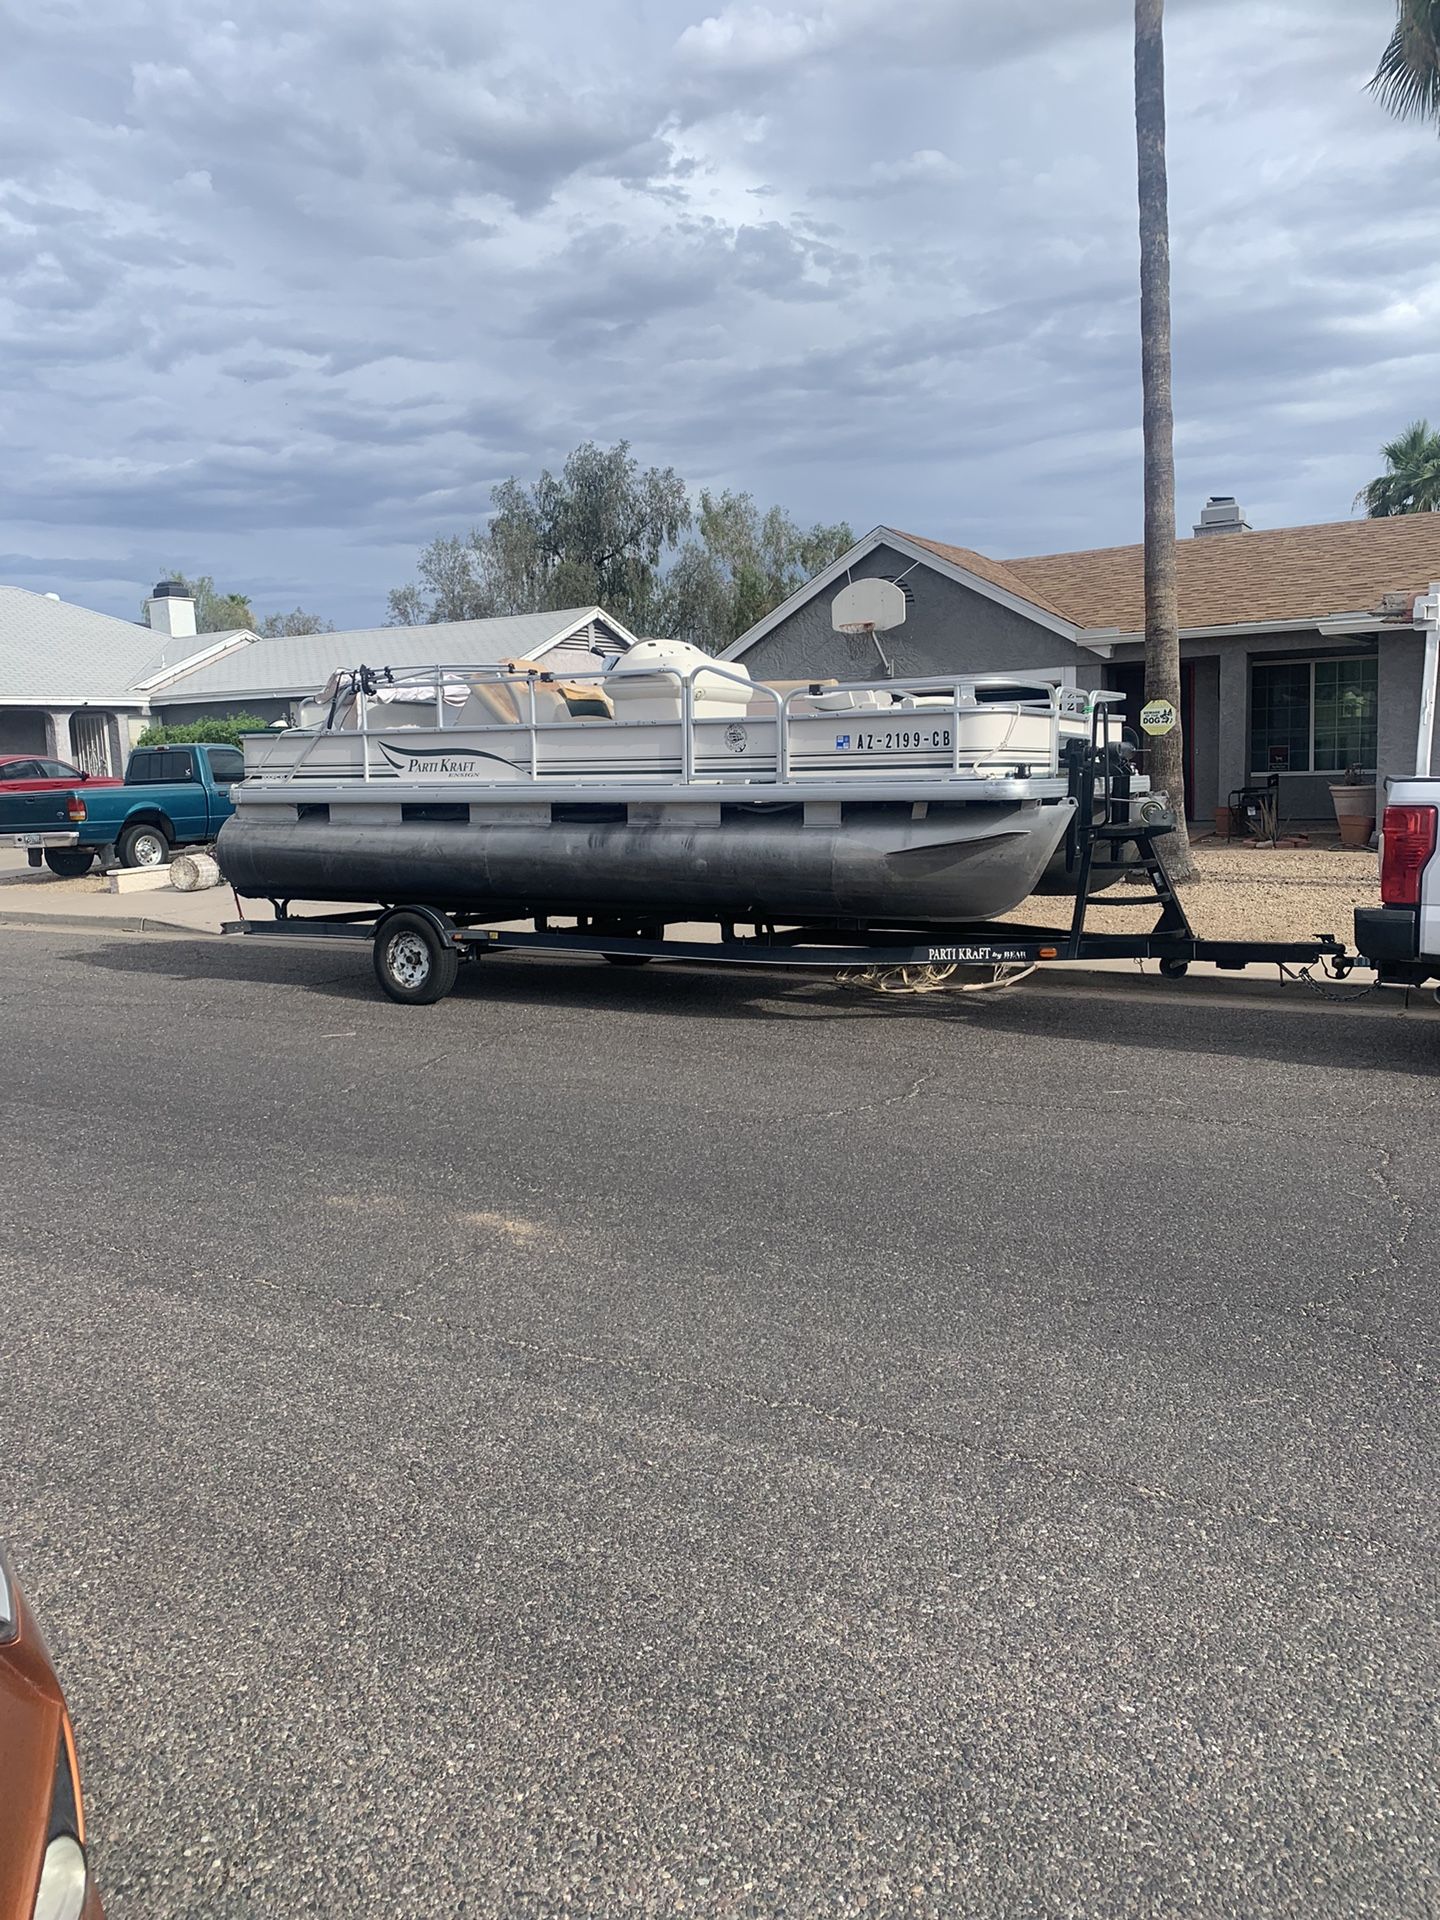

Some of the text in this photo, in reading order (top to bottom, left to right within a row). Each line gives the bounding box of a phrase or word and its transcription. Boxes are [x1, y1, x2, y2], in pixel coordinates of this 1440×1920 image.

[857, 731, 951, 749] AZ-2199-CB
[408, 758, 476, 772] PARTI KRAFT
[928, 947, 1027, 960] PARTI KRAFT by BEAR
